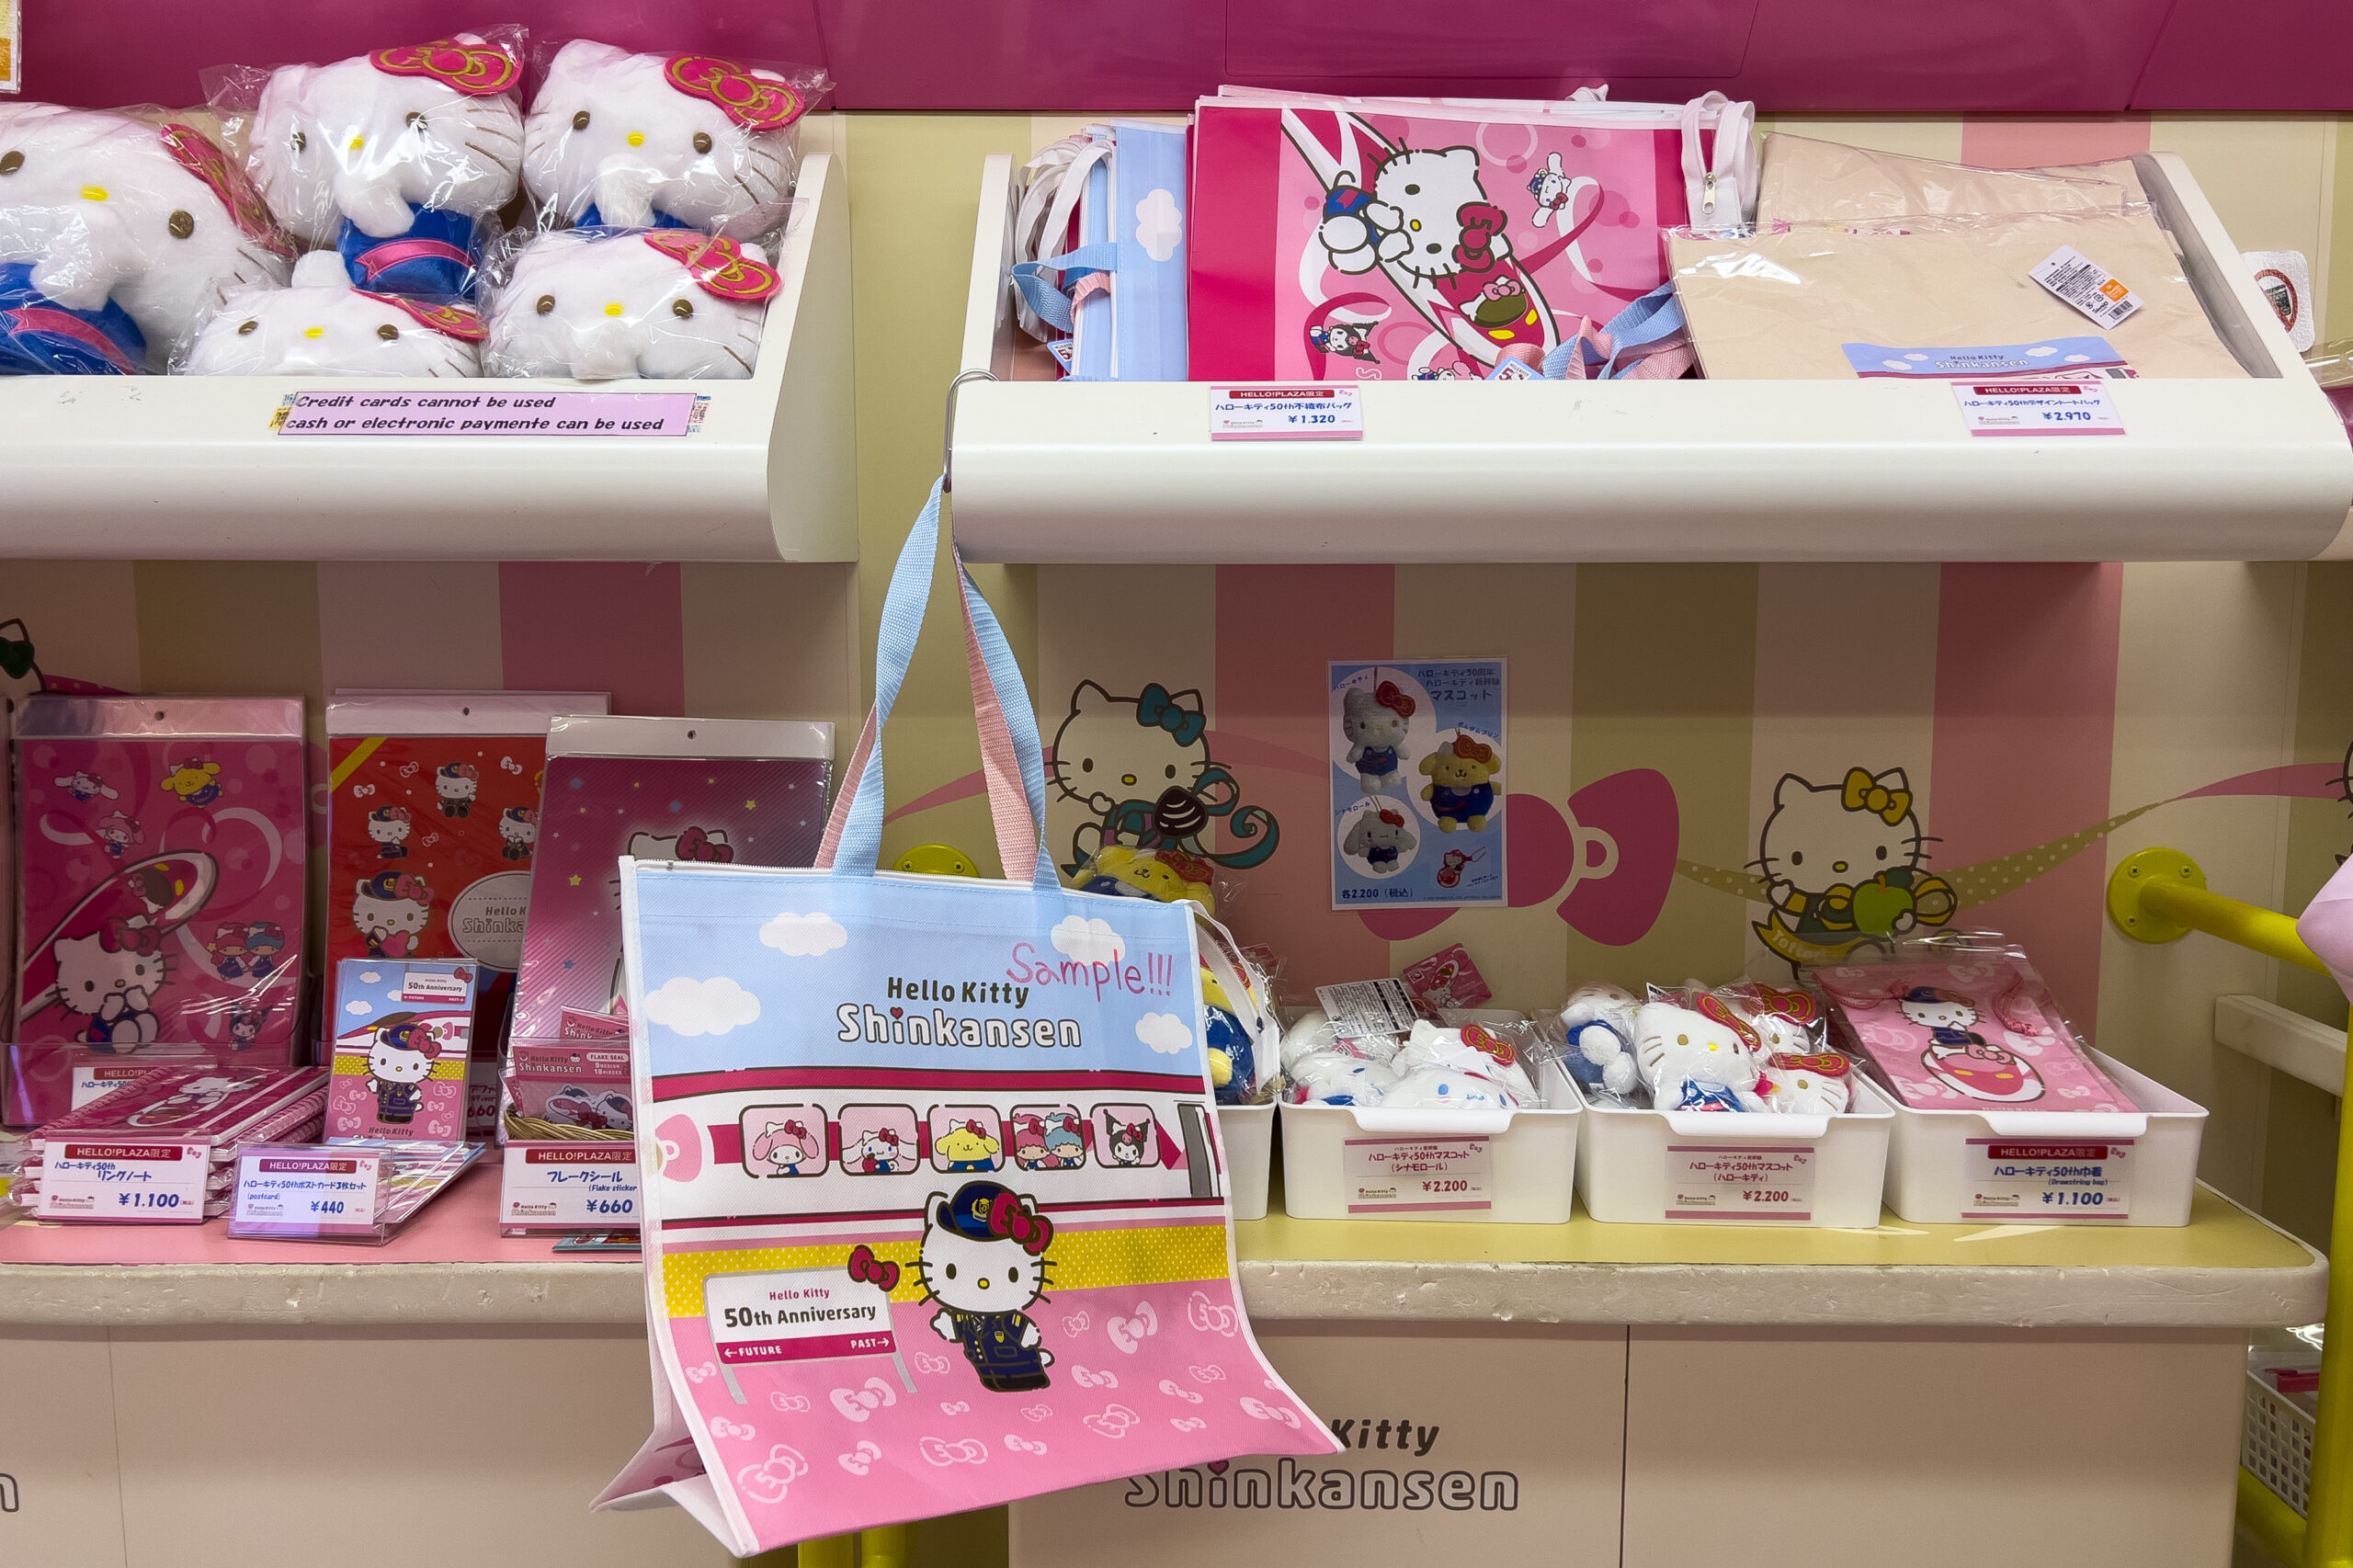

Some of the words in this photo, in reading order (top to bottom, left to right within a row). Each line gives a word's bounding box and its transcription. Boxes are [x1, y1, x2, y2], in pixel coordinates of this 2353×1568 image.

[1935, 359, 2029, 369] Shinkansen
[1984, 386, 2071, 394] HELLO!PLAZA限定
[296, 396, 355, 408] Credit
[360, 396, 412, 408] cards
[417, 396, 481, 408] cannot
[486, 396, 507, 408] be
[513, 396, 556, 408] used
[285, 418, 328, 430] cash
[335, 418, 356, 430] or
[361, 417, 455, 430] electronic
[460, 417, 550, 433] paymente
[556, 419, 588, 430] can
[595, 418, 615, 430] be
[620, 418, 664, 431] used
[1431, 689, 1493, 700] マスコット
[485, 907, 517, 915] Hello
[1006, 942, 1173, 1002] Sample!!!
[408, 982, 425, 990] 50th
[426, 984, 462, 993] Anniversary
[887, 977, 955, 1003] Hello
[961, 982, 1029, 1008] Kitty
[836, 1003, 1083, 1048] Shinkansen
[519, 1062, 582, 1074] Shinkansen
[369, 1127, 391, 1135] Hello
[392, 1128, 415, 1137] Kitty
[77, 1148, 171, 1158] HELLO!PLAZA限定
[538, 1152, 632, 1161] HELLO!PLAZA限定
[1369, 1151, 1470, 1162] ハローキティ50thマスコット
[2001, 1148, 2096, 1157] HELLO!PLAZA限定
[55, 1162, 116, 1170] ハローキティ50th
[269, 1161, 347, 1171] HELLO!PLAZA限定
[1392, 1163, 1448, 1173] (シナモロール)
[1689, 1162, 1793, 1172] ハローキティ50thマスコット
[1994, 1166, 2102, 1177] ハローキティ50th巾着
[97, 1171, 152, 1182] リングノート
[547, 1171, 622, 1182] フレークシール
[1713, 1173, 1768, 1183] (ハローキティ)
[311, 1200, 344, 1214] ¥440
[586, 1199, 633, 1213] ¥660
[769, 1290, 800, 1302] Hello
[803, 1288, 830, 1300] Kitty
[724, 1306, 772, 1328] 50th
[777, 1304, 876, 1325] Anniversary
[851, 1337, 876, 1349] PAST
[739, 1345, 782, 1357] FUTURE
[1330, 1418, 1440, 1457] Kitty
